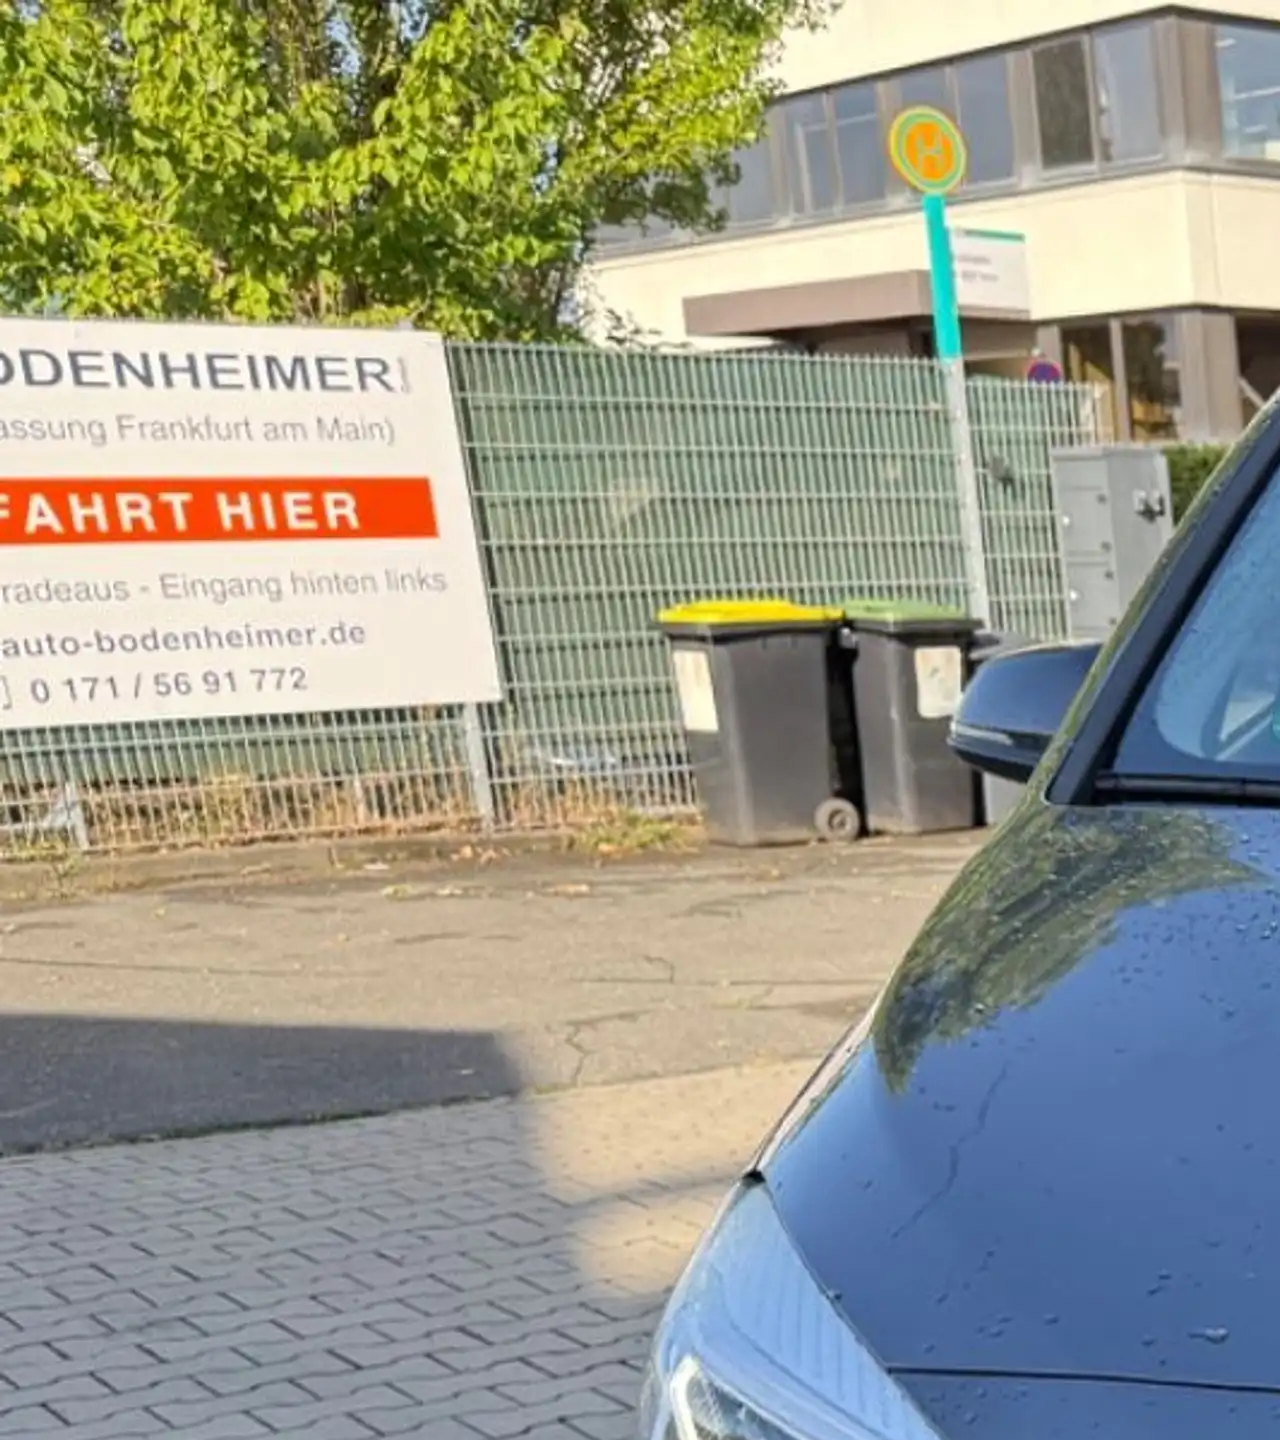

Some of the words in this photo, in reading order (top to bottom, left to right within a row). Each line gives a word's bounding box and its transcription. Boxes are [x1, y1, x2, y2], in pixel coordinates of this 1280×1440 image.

[115, 413, 253, 442] Frankfurt
[263, 420, 308, 441] am
[316, 415, 395, 446] Main)
[216, 490, 360, 533] HIER
[159, 571, 282, 606] Eingang
[290, 568, 378, 596] hinten
[384, 563, 448, 592] links
[1, 620, 366, 658] auto-bodenheimer.de
[153, 671, 192, 696] 56
[202, 669, 237, 694] 91
[250, 666, 308, 692] 772
